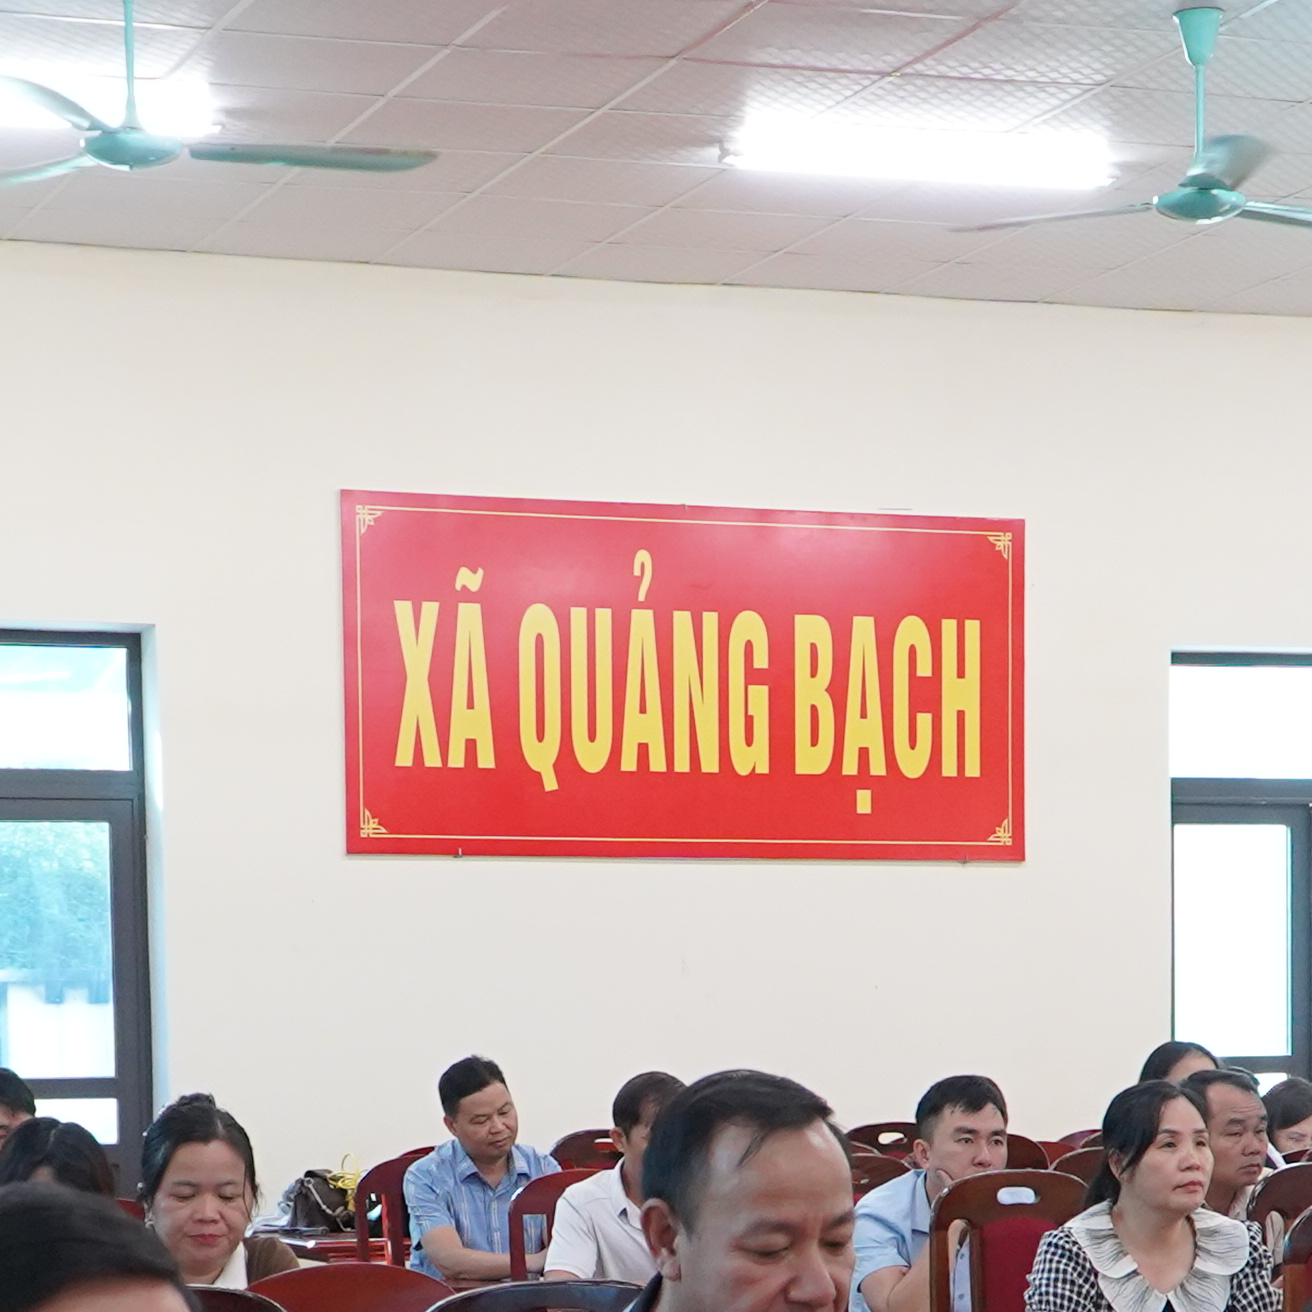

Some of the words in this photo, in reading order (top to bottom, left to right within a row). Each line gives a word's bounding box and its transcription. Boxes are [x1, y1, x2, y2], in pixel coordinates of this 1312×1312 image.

[394, 566, 495, 768] XÃ
[518, 550, 770, 791] QUẢNG
[794, 613, 981, 814] BẠCH
